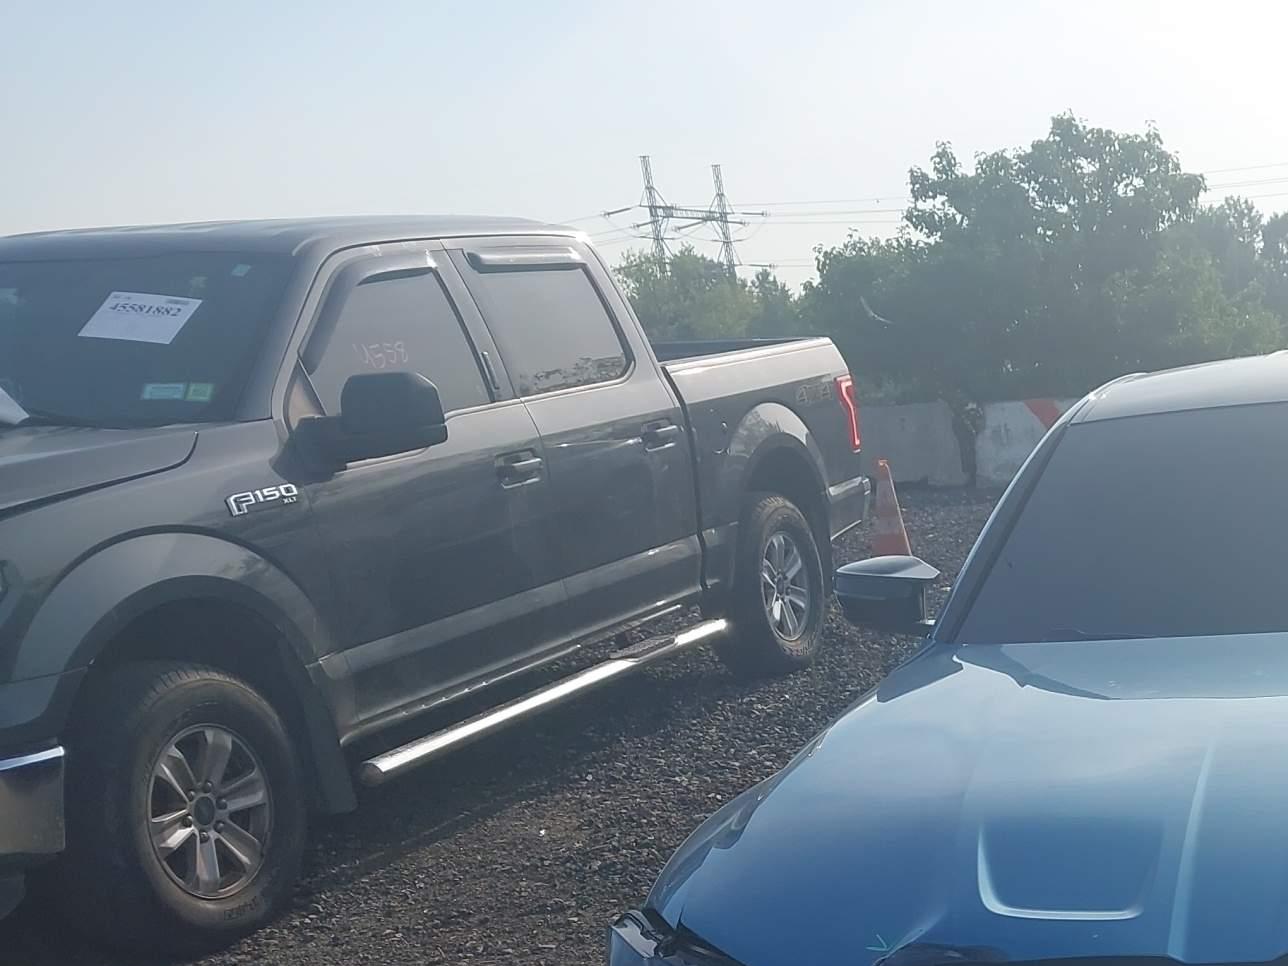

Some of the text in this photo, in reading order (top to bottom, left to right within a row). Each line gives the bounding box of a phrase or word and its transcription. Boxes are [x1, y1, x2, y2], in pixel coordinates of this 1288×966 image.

[109, 302, 182, 317] 45581882
[225, 483, 299, 517] F150
[282, 496, 298, 505] XLT
